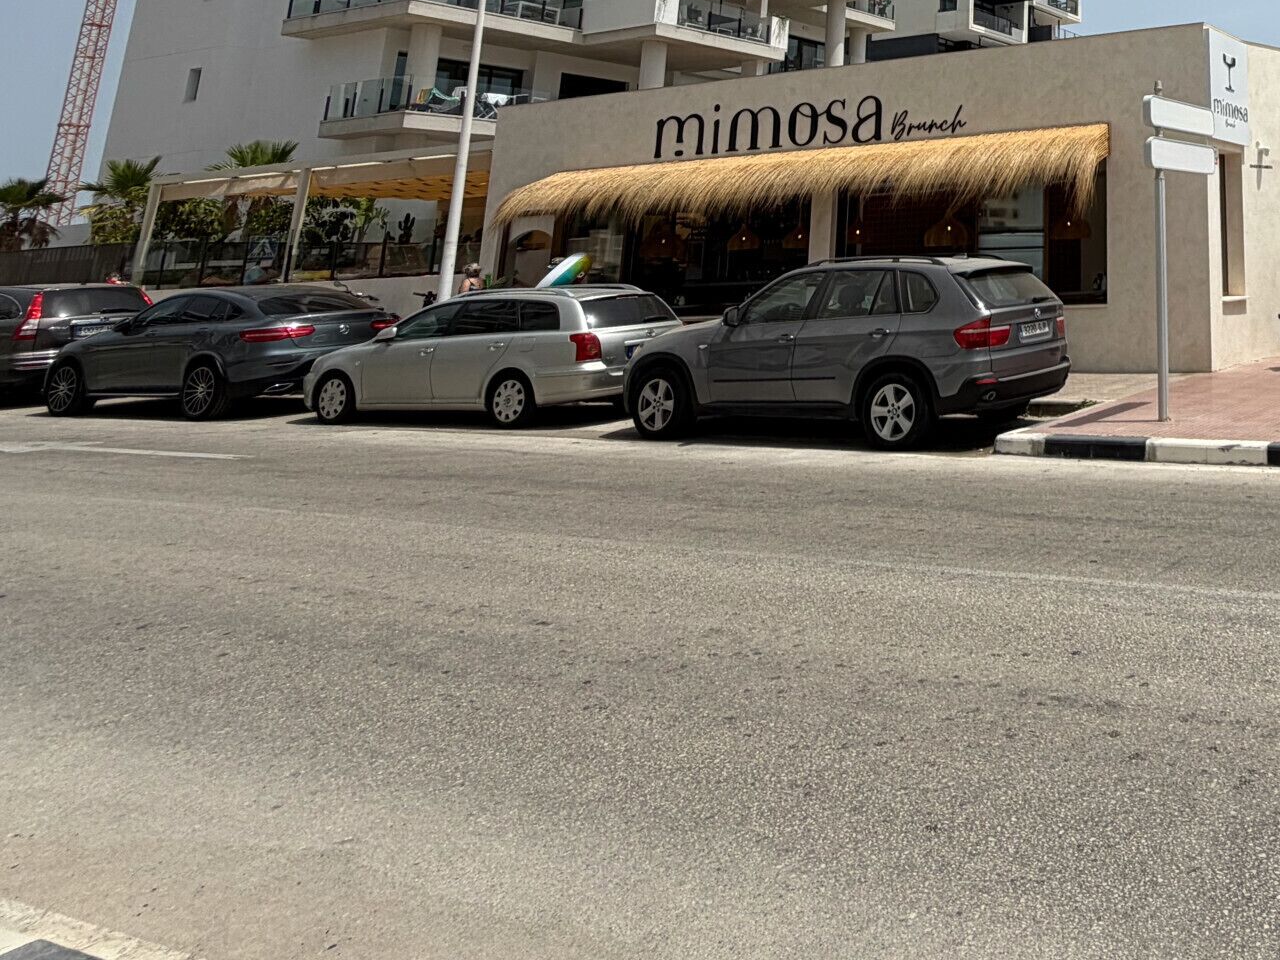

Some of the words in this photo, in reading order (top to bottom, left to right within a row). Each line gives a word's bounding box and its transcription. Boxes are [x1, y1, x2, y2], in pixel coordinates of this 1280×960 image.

[653, 95, 883, 158] mimosa
[890, 104, 967, 141] Brunch
[1213, 98, 1249, 123] mimosa
